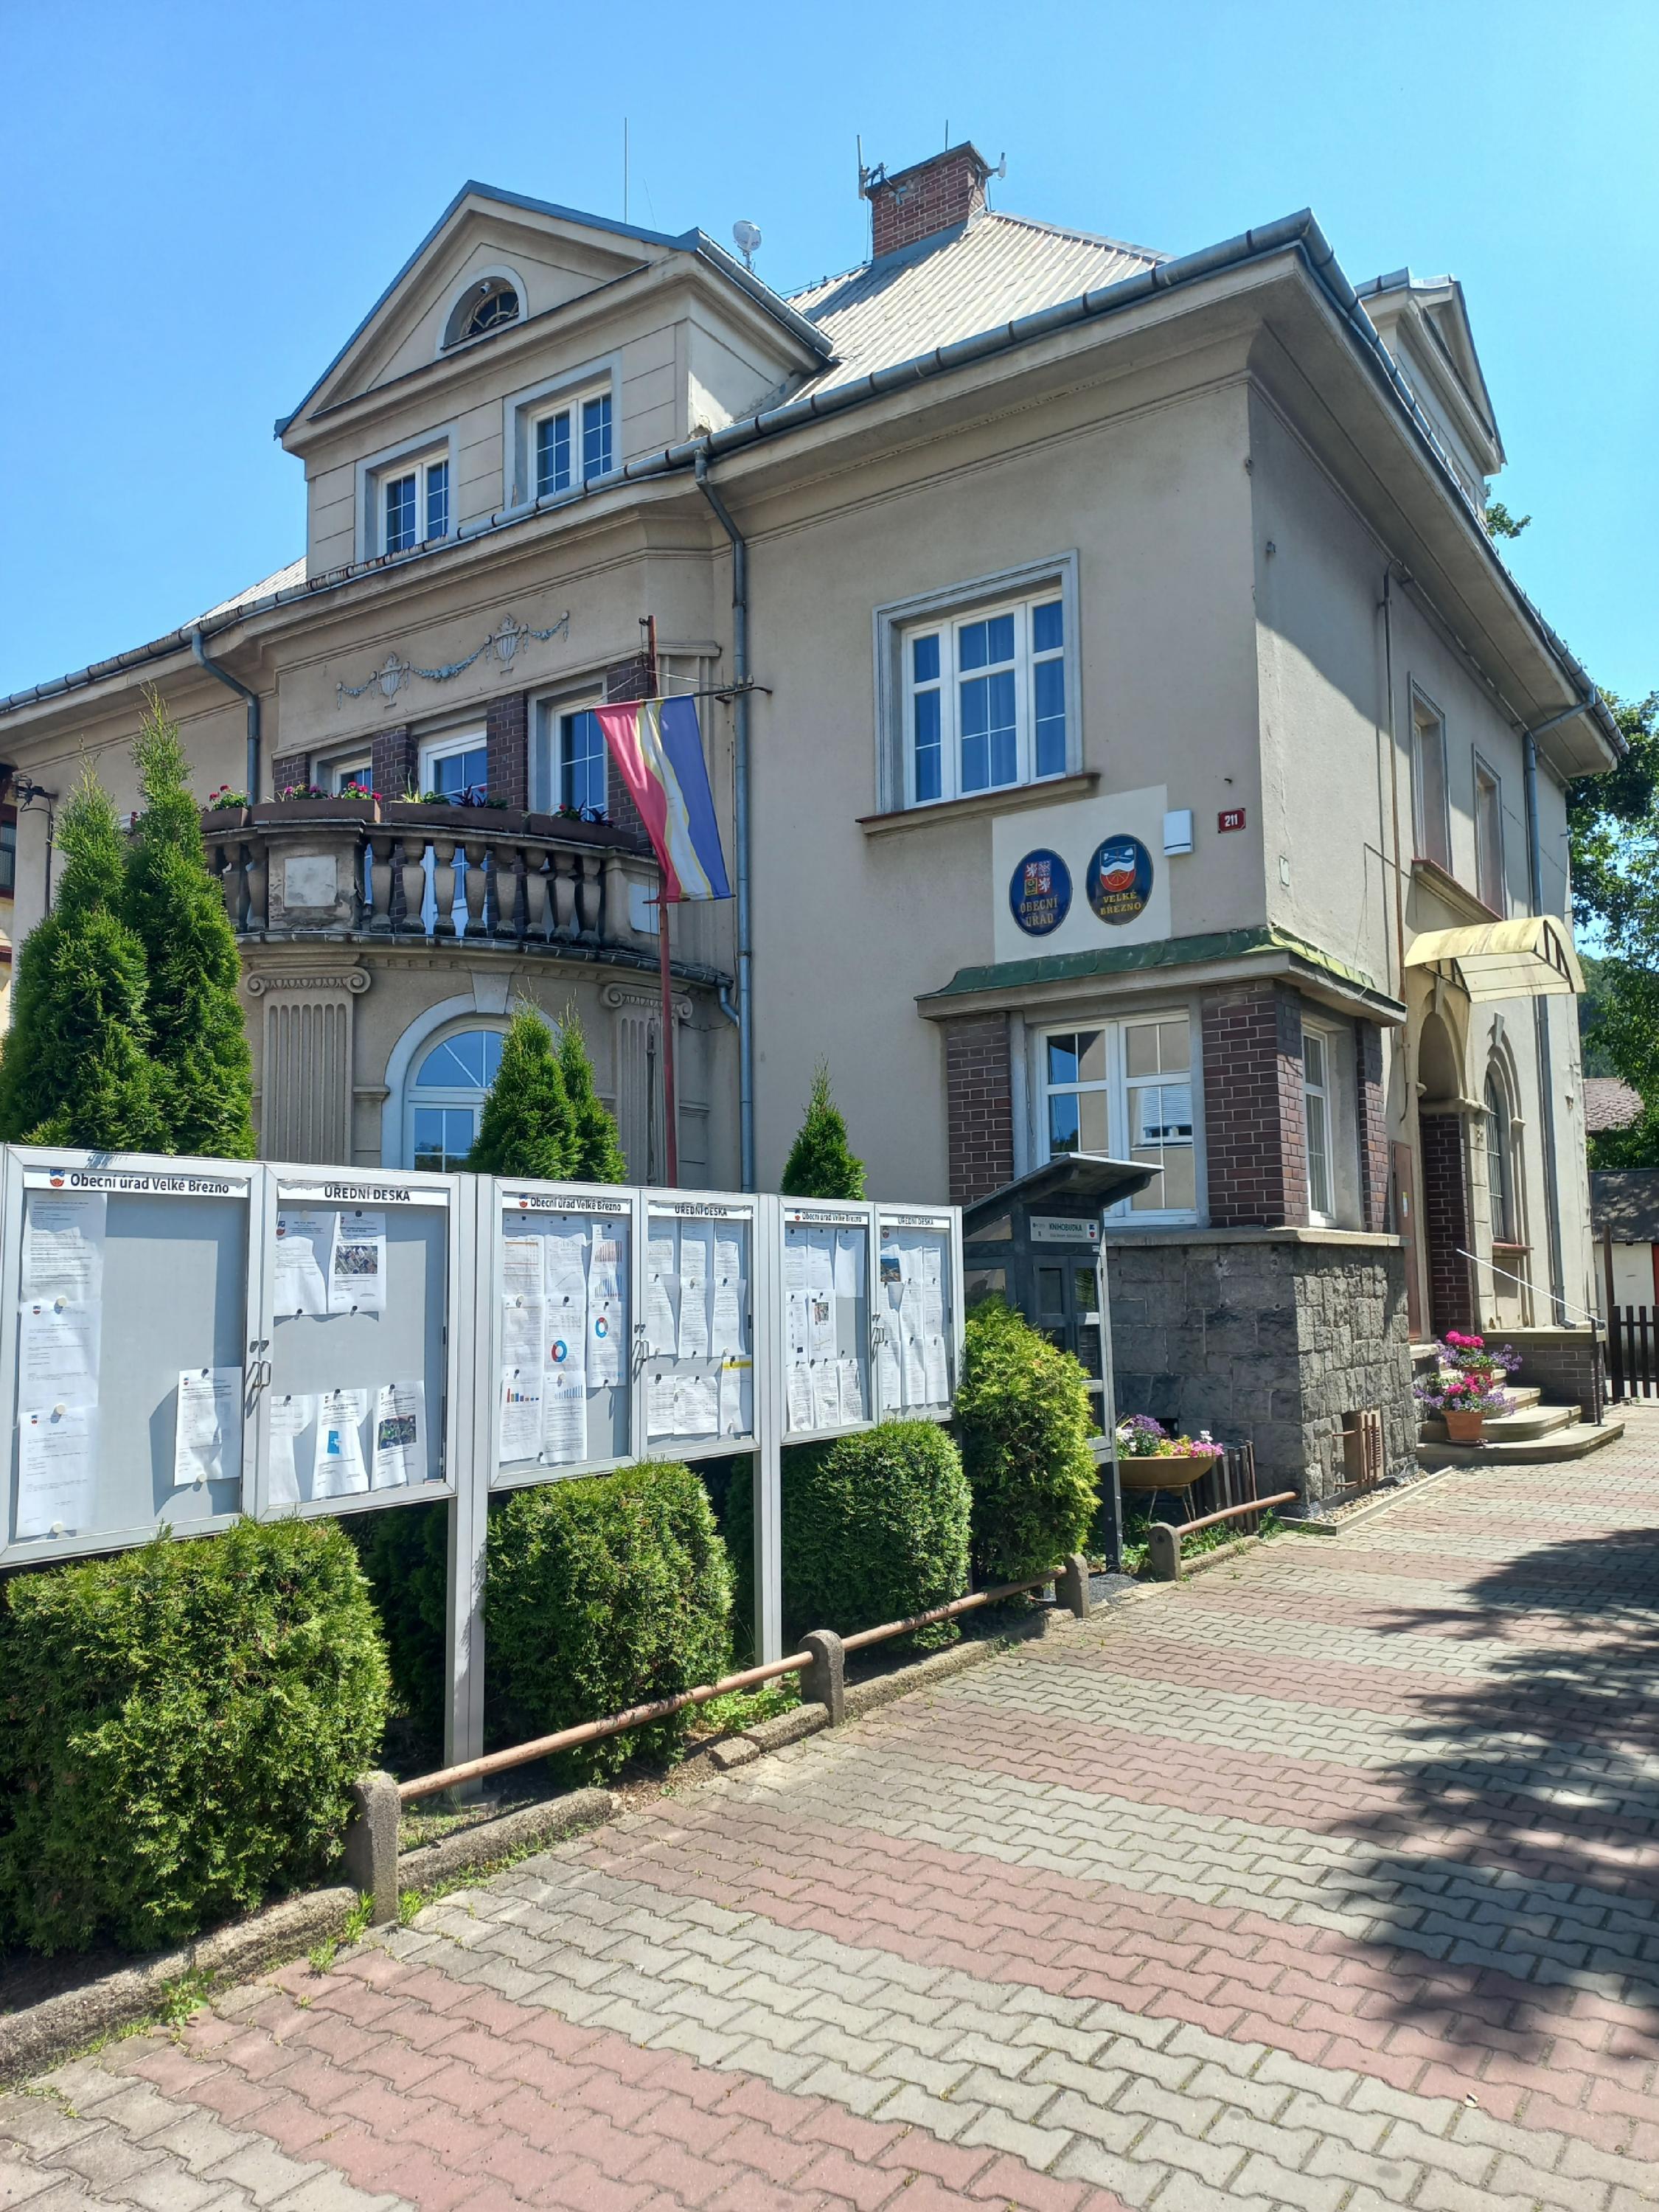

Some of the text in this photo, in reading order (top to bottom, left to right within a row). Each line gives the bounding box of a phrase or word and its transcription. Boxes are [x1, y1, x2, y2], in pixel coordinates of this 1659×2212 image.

[1225, 814, 1237, 827] 211
[1103, 890, 1137, 903] VELKÉ
[1020, 894, 1058, 913] OBECNÍ
[1026, 913, 1054, 926] ÚŘAD
[71, 1172, 229, 1194] Obecní úřad Velké Březno
[324, 1183, 410, 1201] ÚŘEDNÍ DESKA
[531, 1197, 557, 1208] Obecní
[577, 1198, 596, 1210] Velké
[704, 1206, 727, 1217] DESKA
[1048, 1222, 1082, 1232] KNIHOBUDKA
